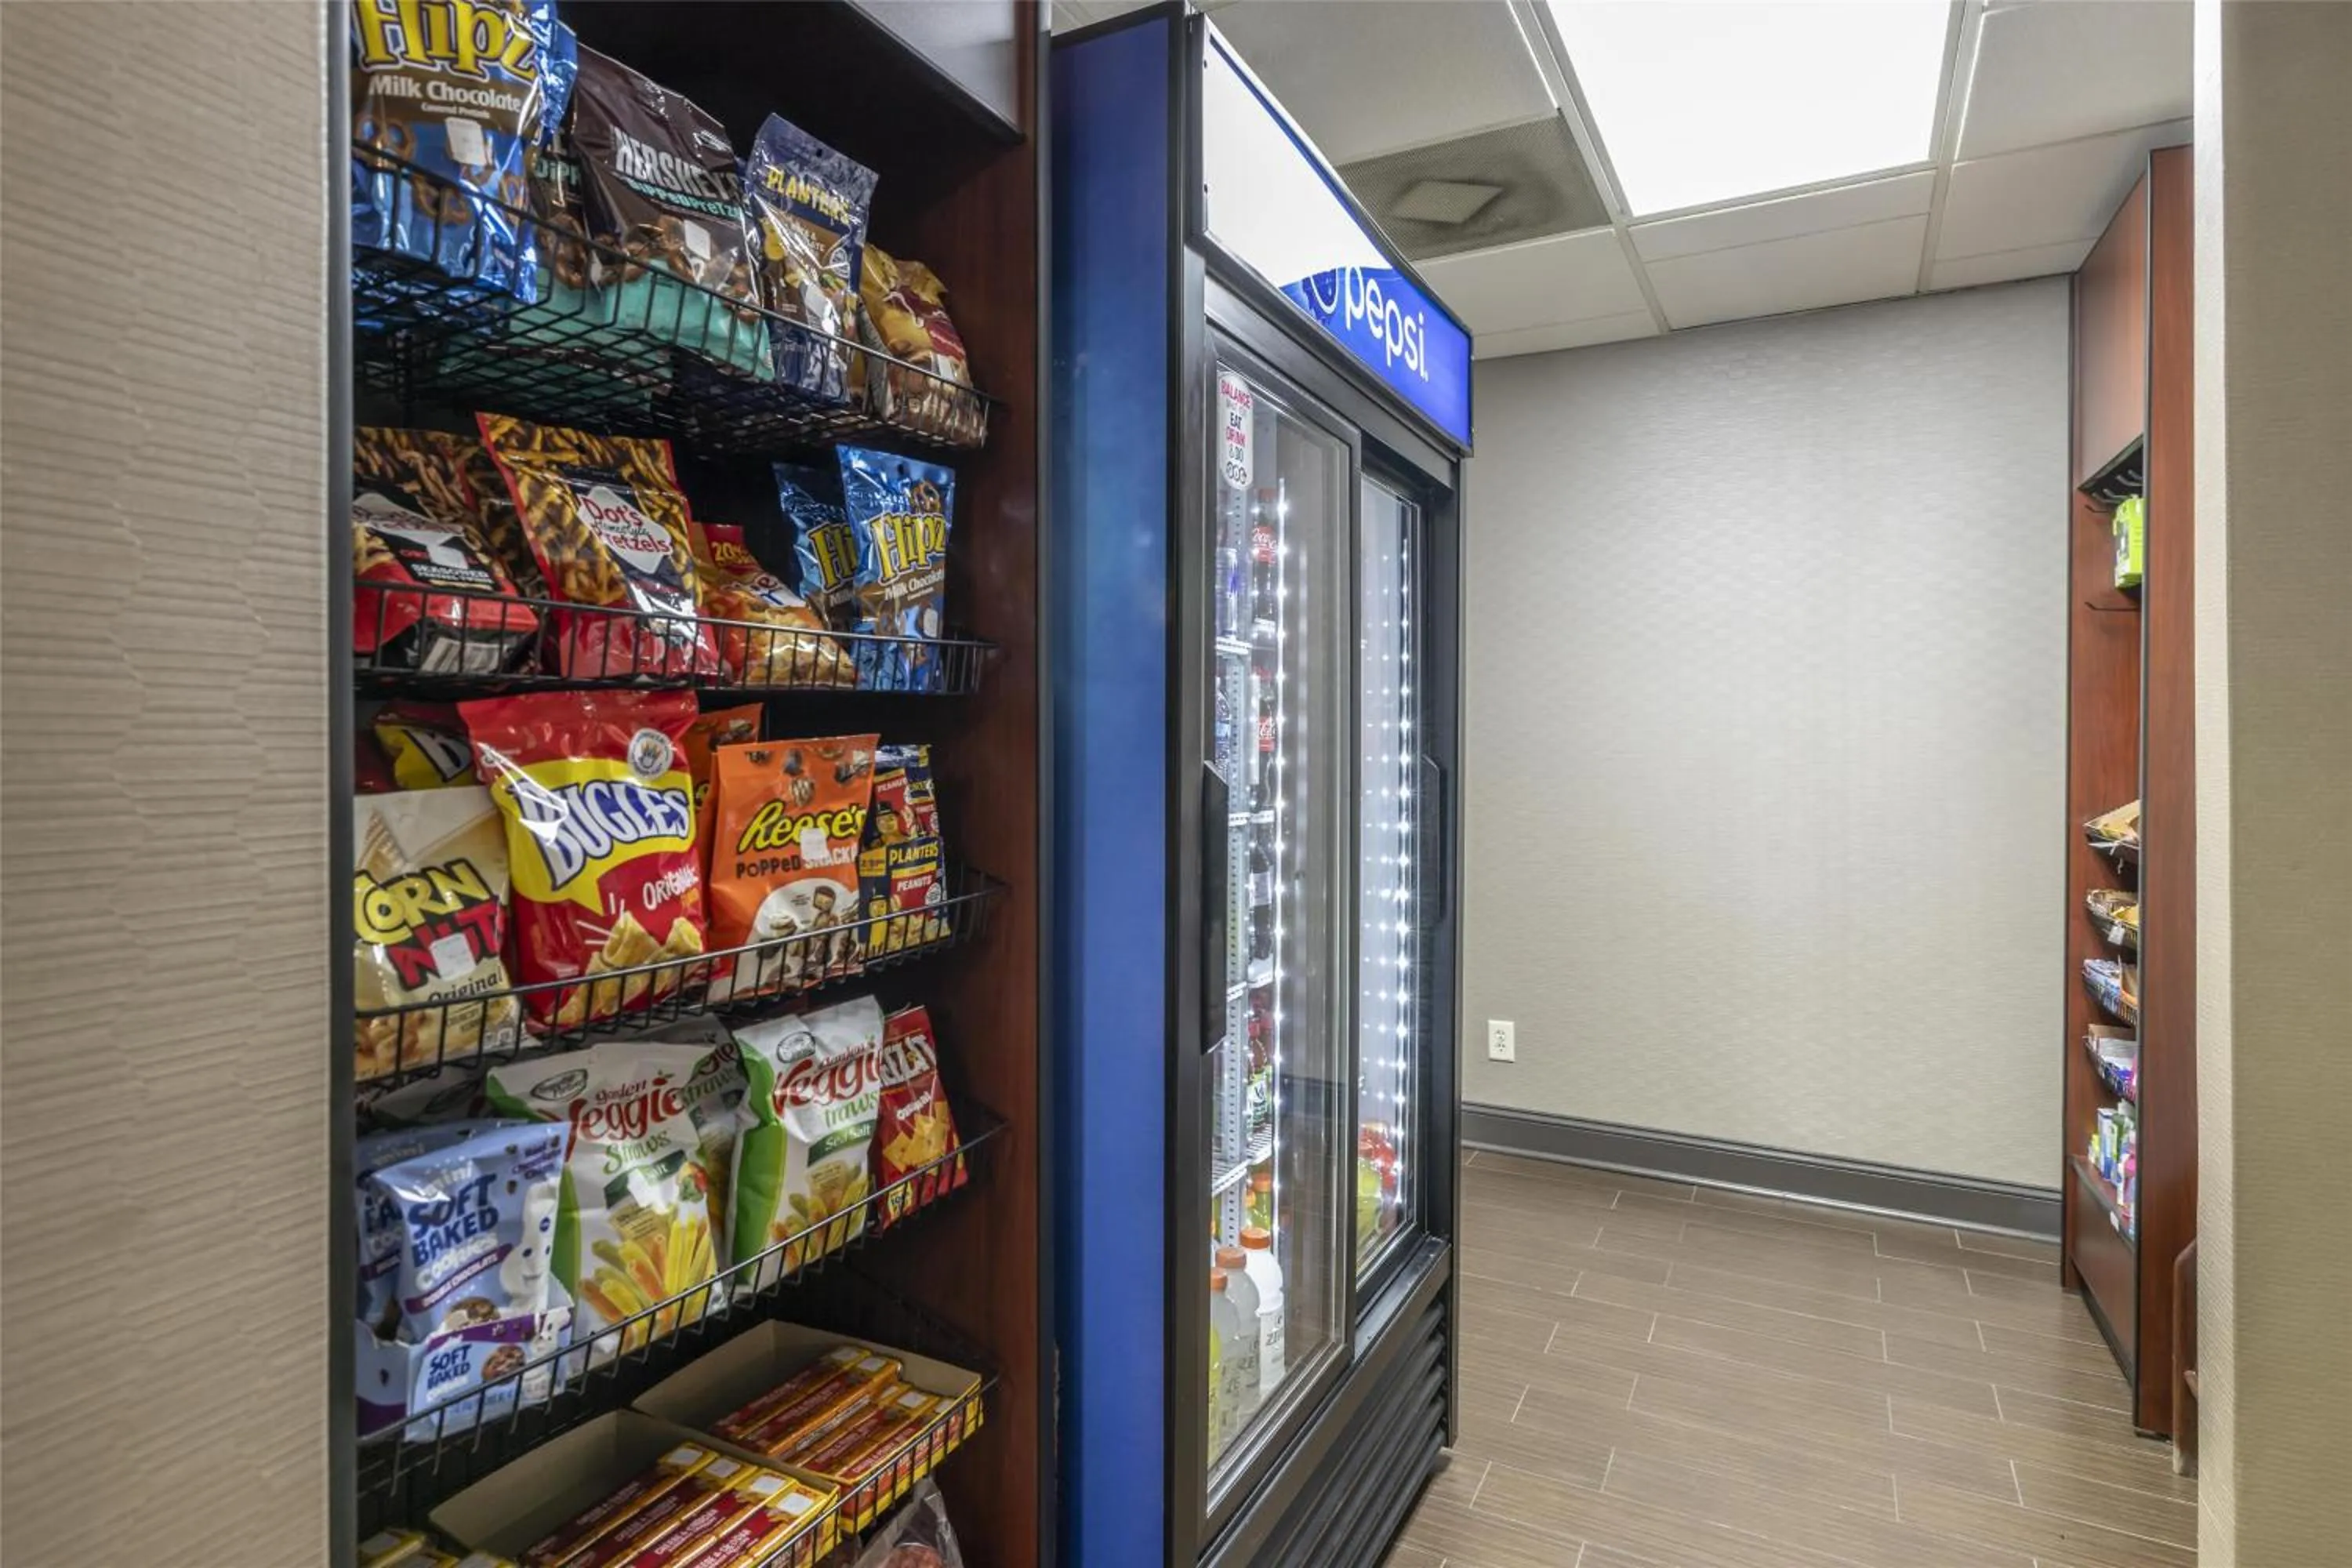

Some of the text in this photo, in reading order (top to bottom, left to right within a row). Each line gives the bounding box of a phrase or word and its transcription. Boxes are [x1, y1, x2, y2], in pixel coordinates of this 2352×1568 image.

[368, 75, 522, 112] Milk Chocolate
[580, 496, 643, 527] Dot's
[508, 779, 690, 892] BUGLES
[889, 841, 938, 866] PLANTERS
[353, 857, 492, 946] CORN
[896, 874, 933, 892] PEANUTS
[772, 1051, 881, 1118] Veggi
[408, 1174, 497, 1240] SOFT
[412, 1207, 500, 1268] BAKED
[427, 1363, 470, 1389] BAKED
[430, 1343, 472, 1374] SOFT
